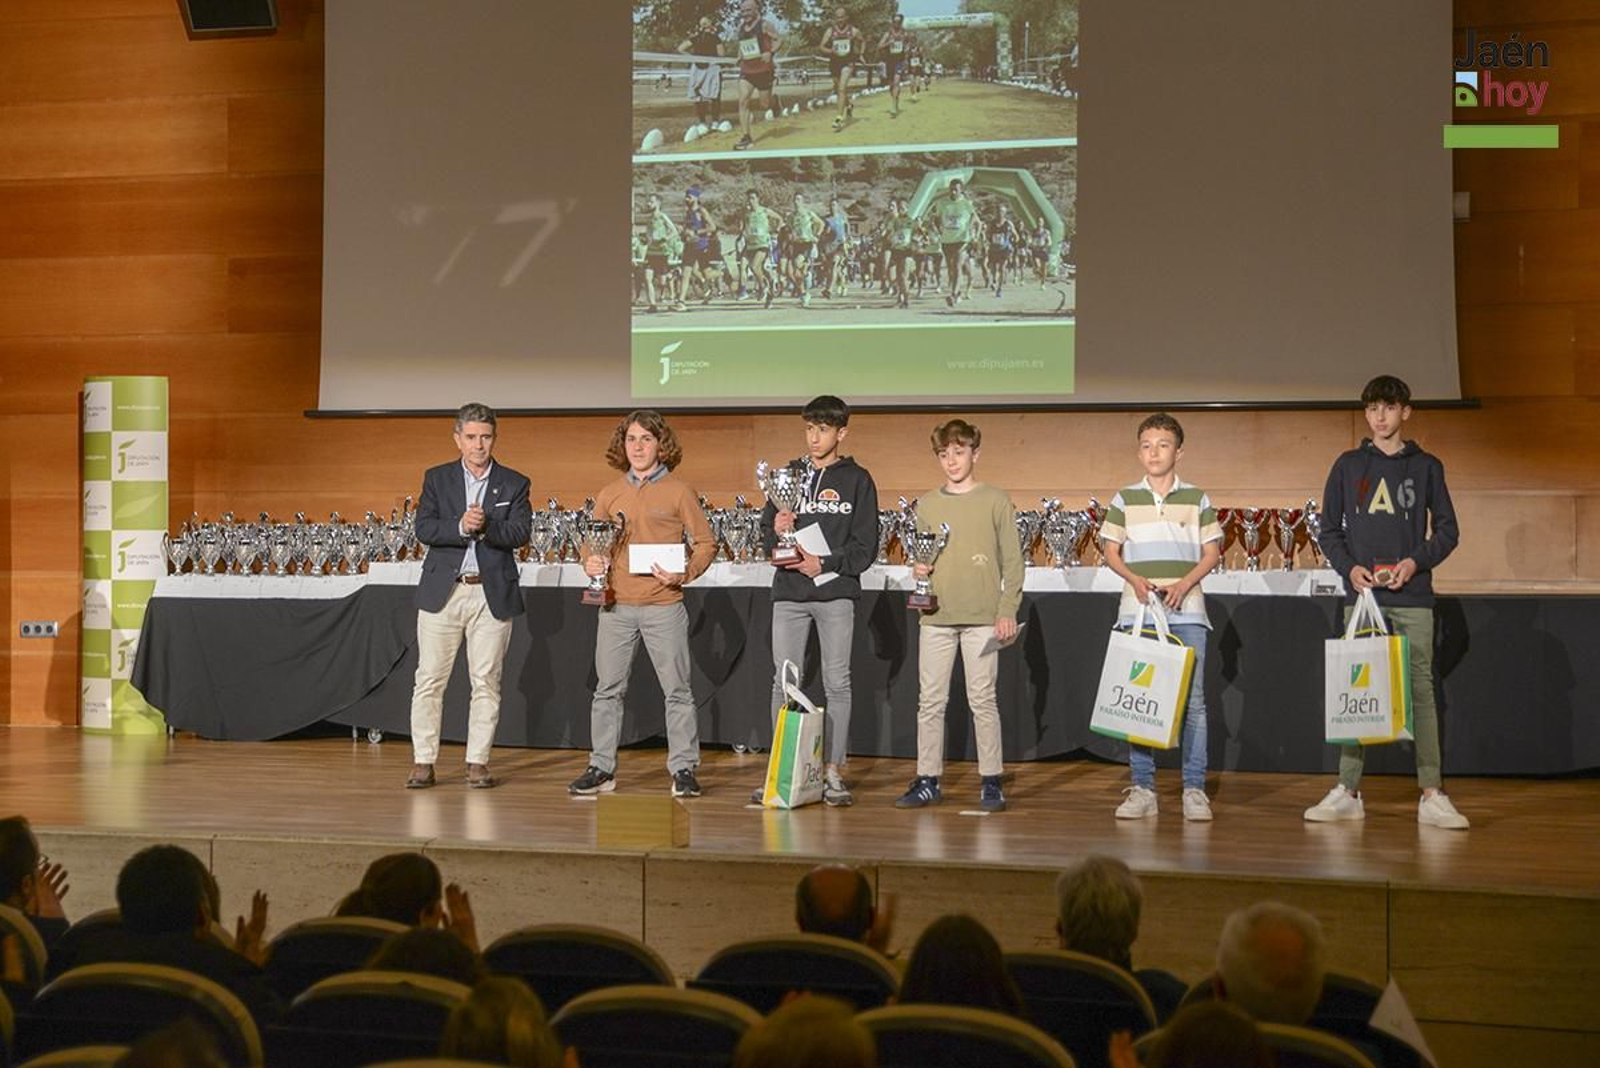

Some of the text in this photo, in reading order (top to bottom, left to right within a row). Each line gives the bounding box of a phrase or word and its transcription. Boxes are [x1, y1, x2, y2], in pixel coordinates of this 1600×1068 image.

[797, 497, 853, 515] lesse
[1110, 685, 1159, 717] Jaén
[1339, 692, 1379, 715] Jaén
[1100, 705, 1165, 727] PARAÍSO INTERIOR
